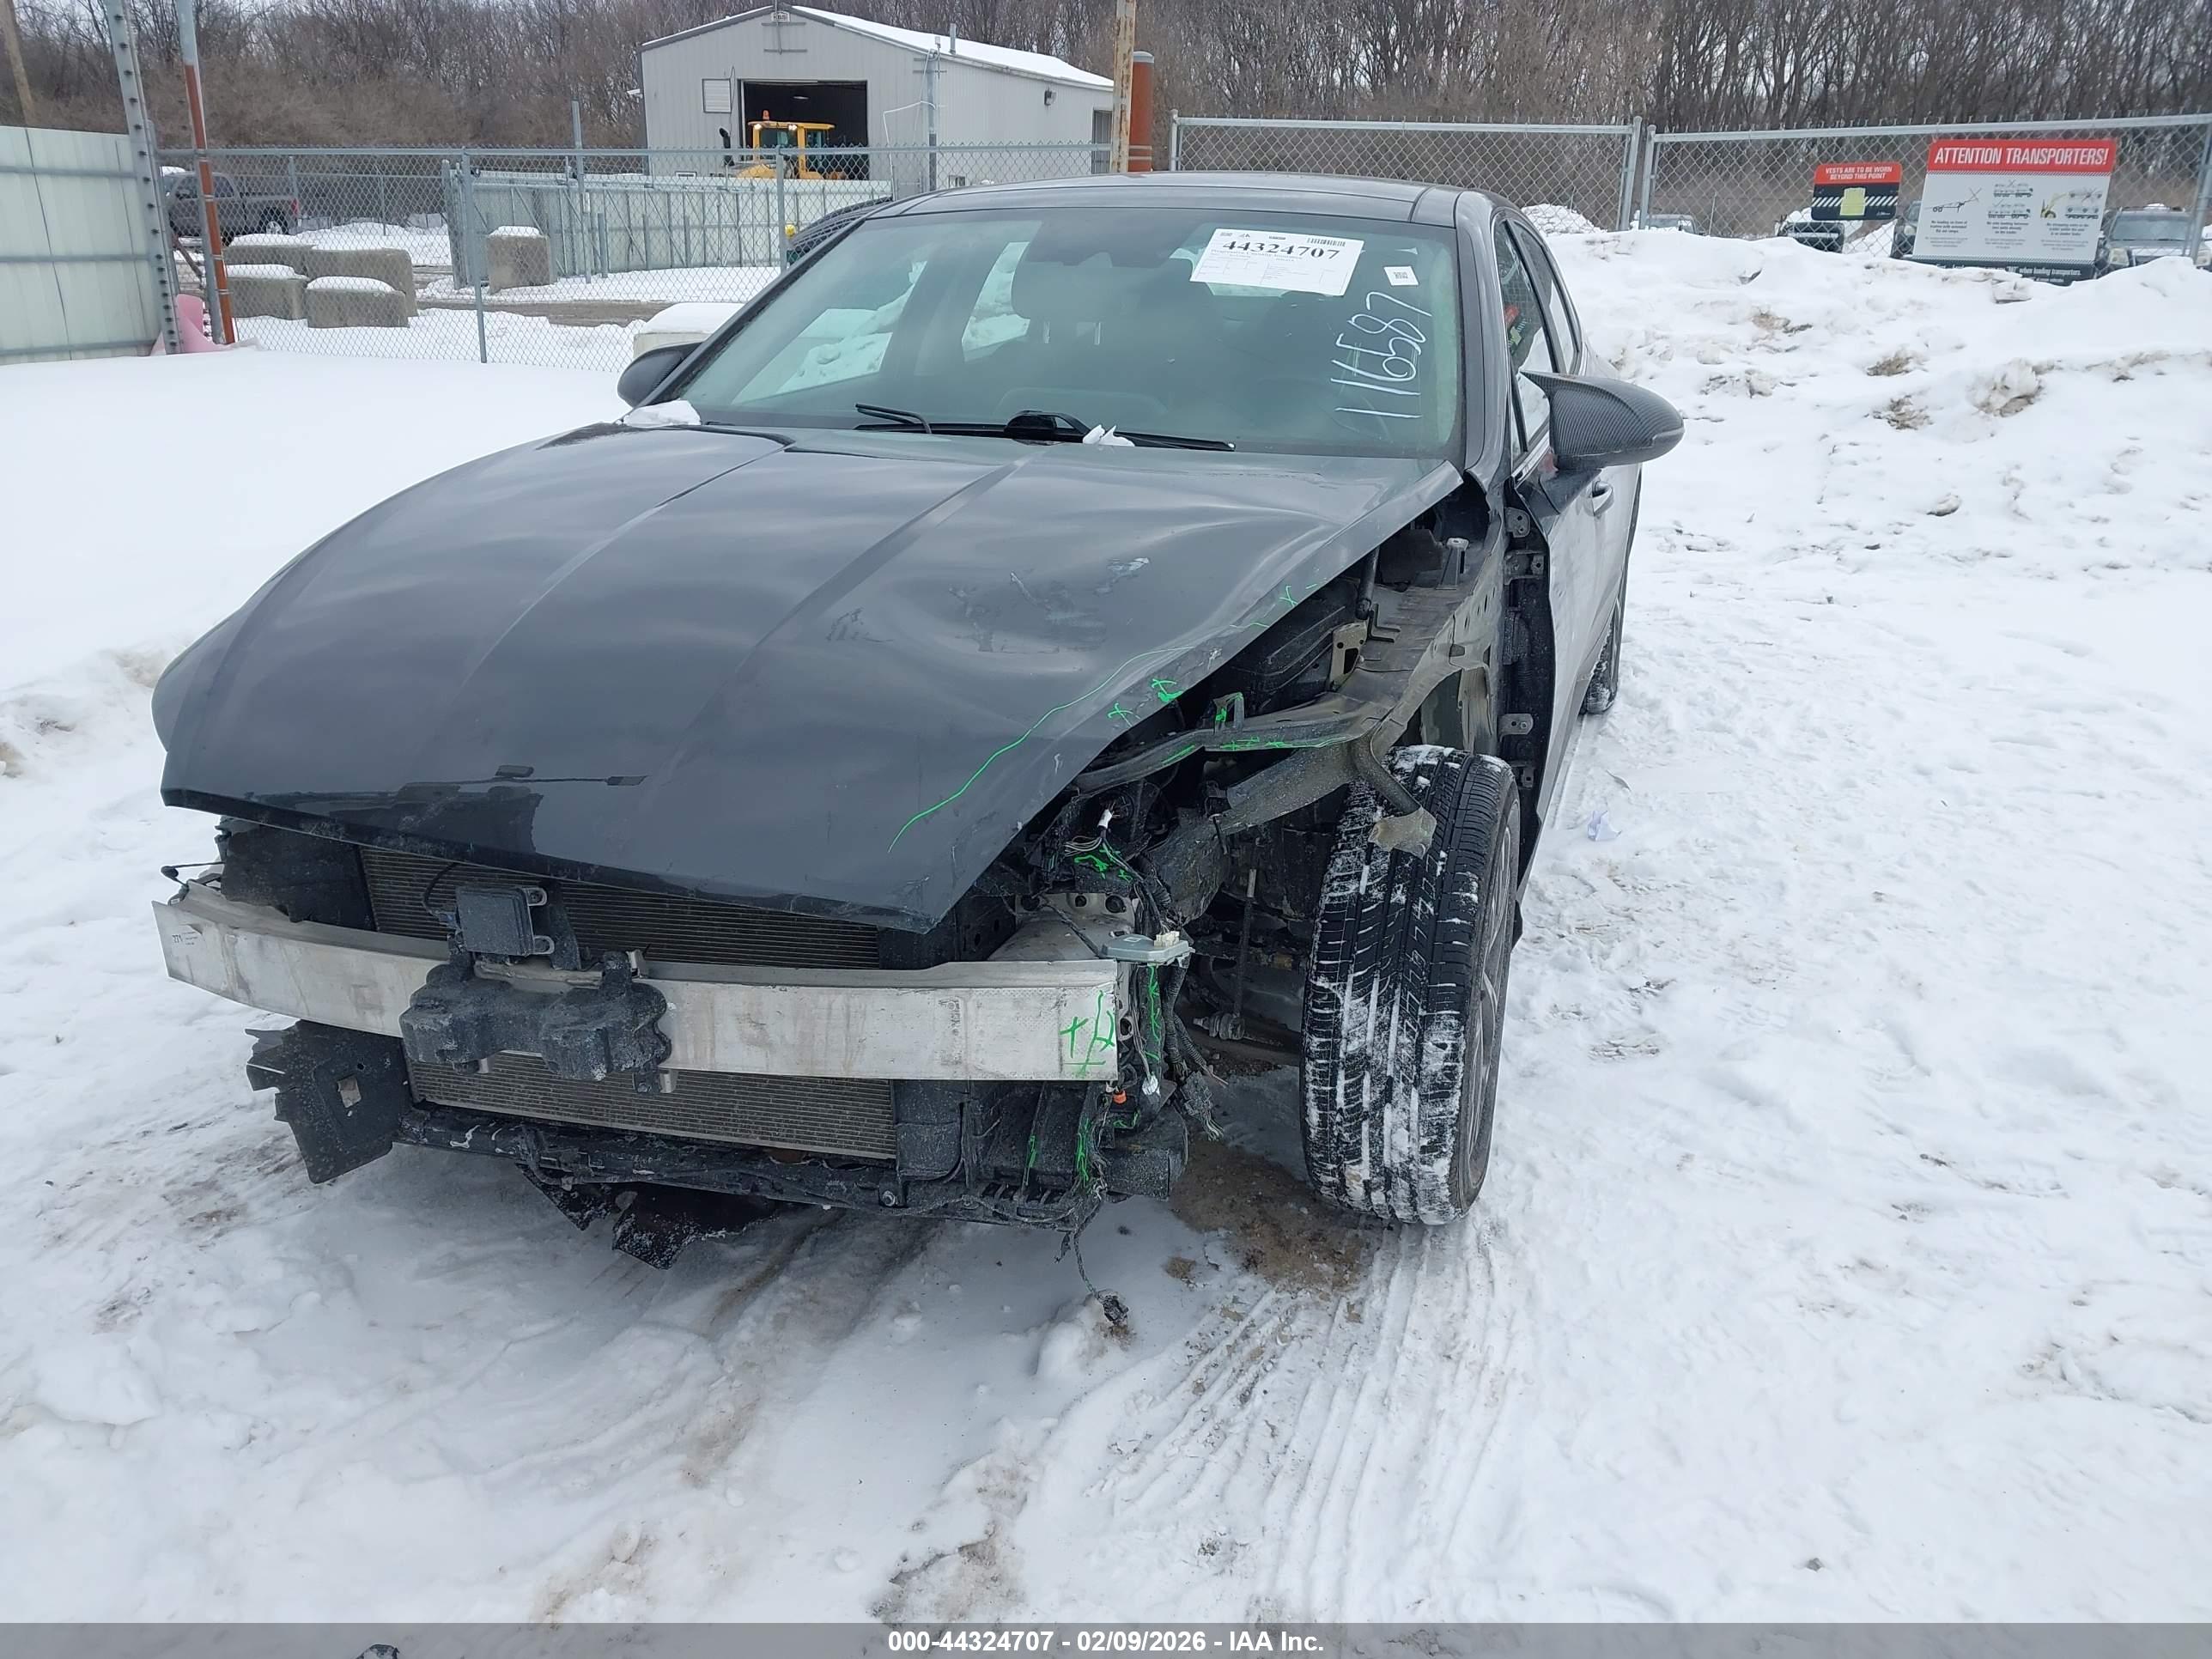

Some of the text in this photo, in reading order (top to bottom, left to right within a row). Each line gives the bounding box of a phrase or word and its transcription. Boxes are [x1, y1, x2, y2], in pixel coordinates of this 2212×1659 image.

[1934, 147, 2110, 166] ATTENTION TRANSPORTERS!
[1222, 240, 1340, 260] 44324707
[1330, 291, 1433, 420] 116587
